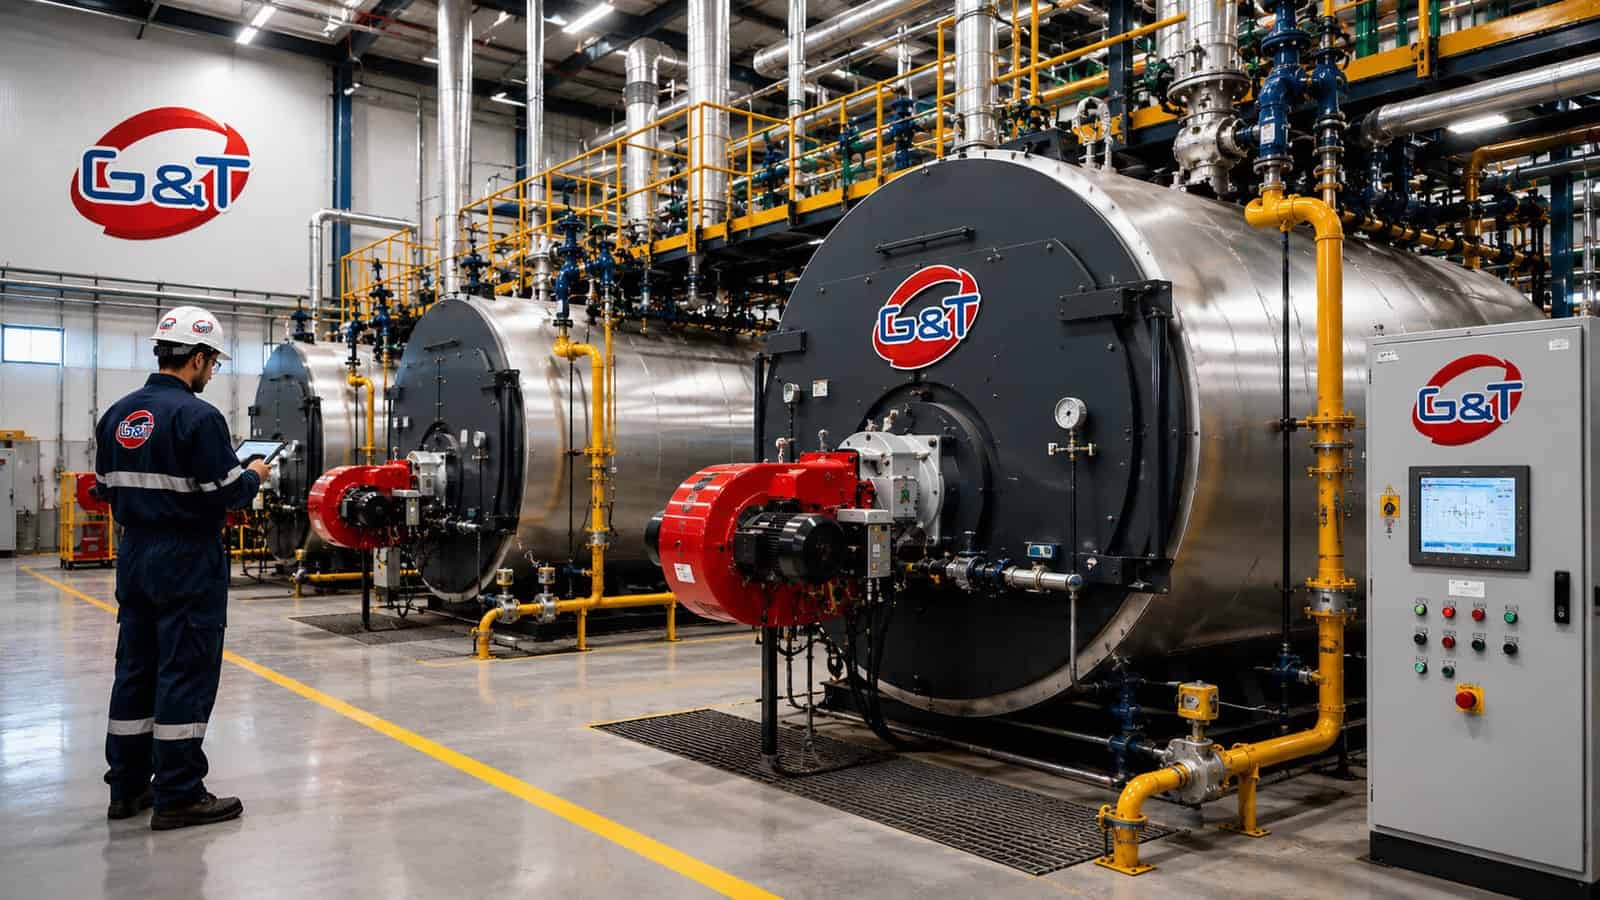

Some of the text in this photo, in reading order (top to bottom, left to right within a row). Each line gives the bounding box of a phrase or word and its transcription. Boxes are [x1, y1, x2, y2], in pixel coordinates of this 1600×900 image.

[81, 147, 252, 210] G&T
[879, 294, 980, 343] G&T
[1417, 381, 1524, 422] G&T
[119, 421, 154, 439] G&T
